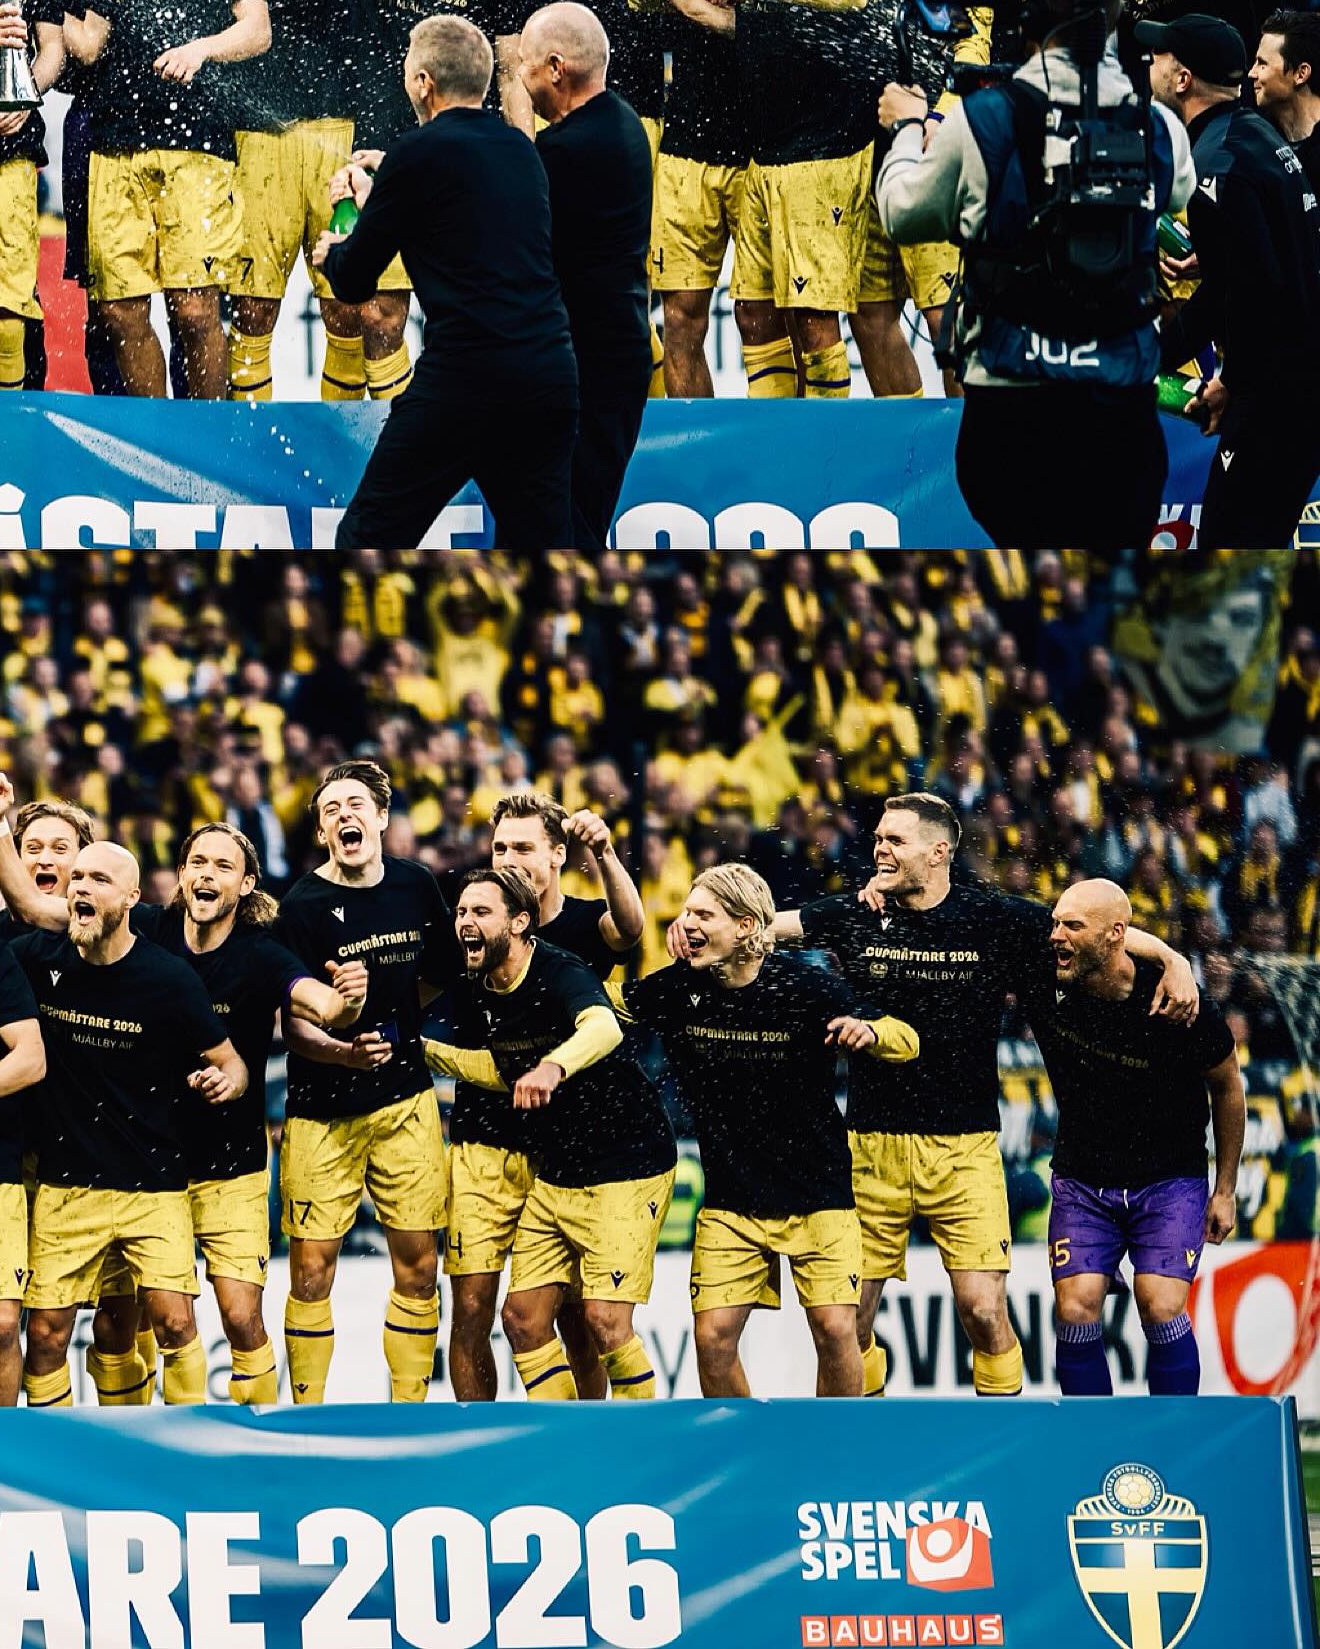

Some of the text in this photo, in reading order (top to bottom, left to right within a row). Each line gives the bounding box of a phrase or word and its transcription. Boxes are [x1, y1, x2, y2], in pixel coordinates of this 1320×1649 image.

[240, 257, 254, 286] 7
[337, 932, 406, 958] CUPMÄSTARE
[864, 946, 978, 963] CUPMÄSTARE 2026
[37, 1001, 143, 1035] CUPMÄSTARE 2026
[760, 1030, 791, 1044] 2026
[288, 1198, 313, 1227] 17
[797, 1501, 991, 1539] SVENSKA
[1111, 1521, 1165, 1537] SvFF
[296, 1503, 682, 1649] 2026
[800, 1543, 900, 1580] SPEL
[806, 1618, 1001, 1643] BAUHAUS
